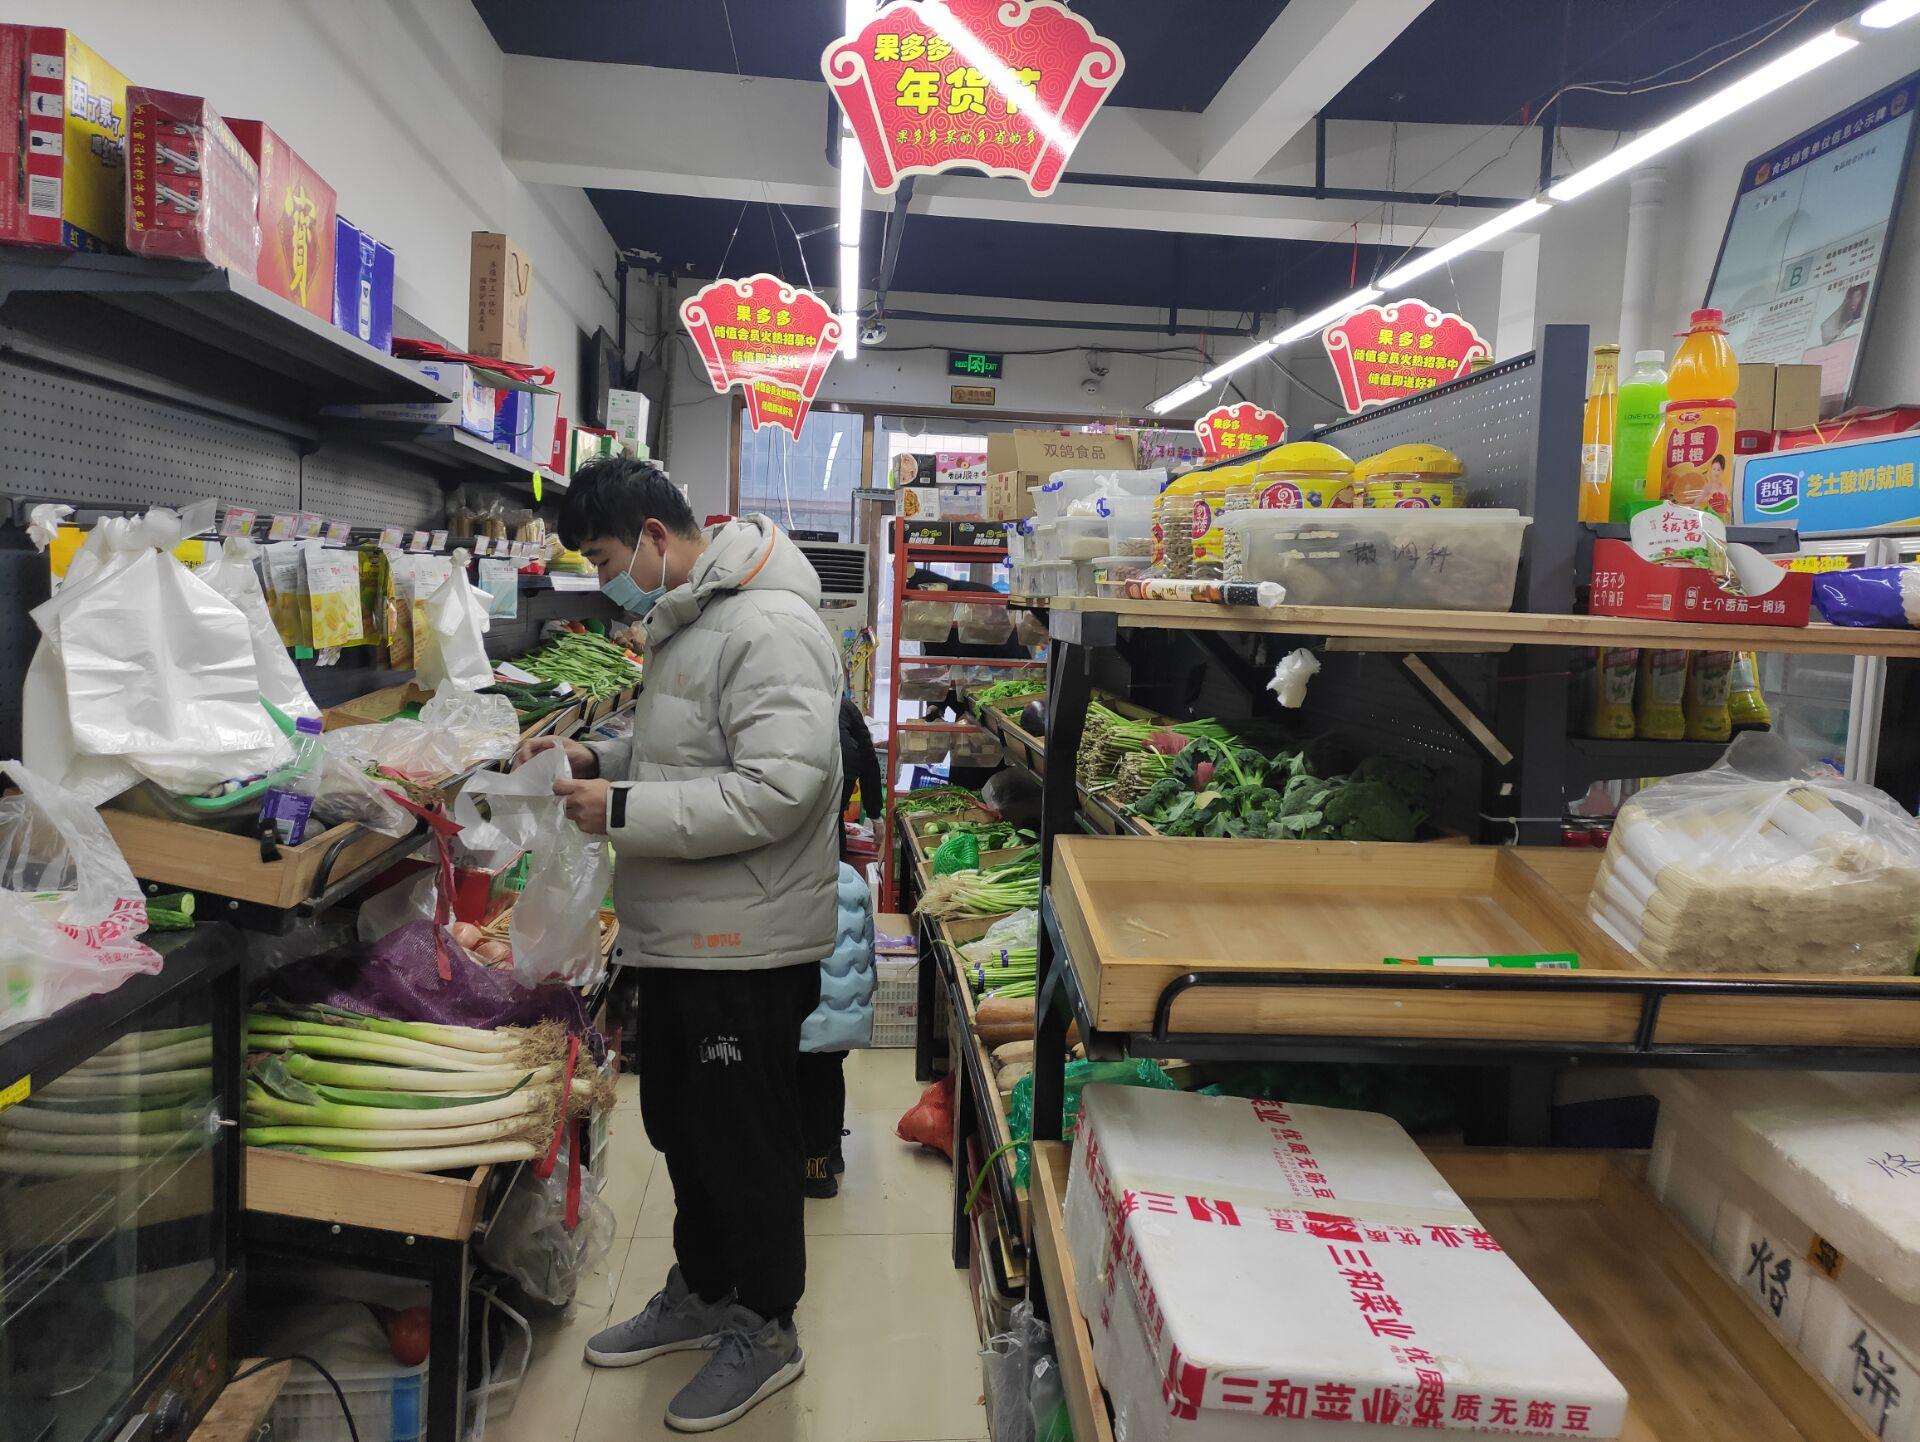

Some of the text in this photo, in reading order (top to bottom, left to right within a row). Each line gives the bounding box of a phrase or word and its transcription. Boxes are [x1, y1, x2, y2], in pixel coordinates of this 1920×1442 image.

[873, 33, 953, 62] 果多多
[70, 77, 121, 136] 困了累了
[1772, 106, 1887, 176] 食品销售单位信息公示牌
[736, 305, 792, 326] 果多多
[713, 325, 817, 348] 储值会员火热招募中
[1378, 328, 1434, 350] 果多多
[1353, 348, 1459, 371] 储值会员火热招募中
[1213, 418, 1241, 430] 果多多
[1671, 432, 1705, 446] 蜂蜜
[1043, 443, 1106, 460] 双鸽食品
[1671, 448, 1704, 462] 甜橙
[1760, 479, 1794, 498] 君乐宝
[1806, 463, 1915, 497] 芝士酸奶就喝
[1594, 572, 1626, 589] 不多不少
[1594, 591, 1624, 607] 七个刚好
[1702, 598, 1786, 614] 七个番茄一锅汤
[1280, 1127, 1336, 1200] 优质无筋豆
[1326, 1244, 1416, 1340] 三和菜业
[1221, 1377, 1400, 1424] 三和菜业
